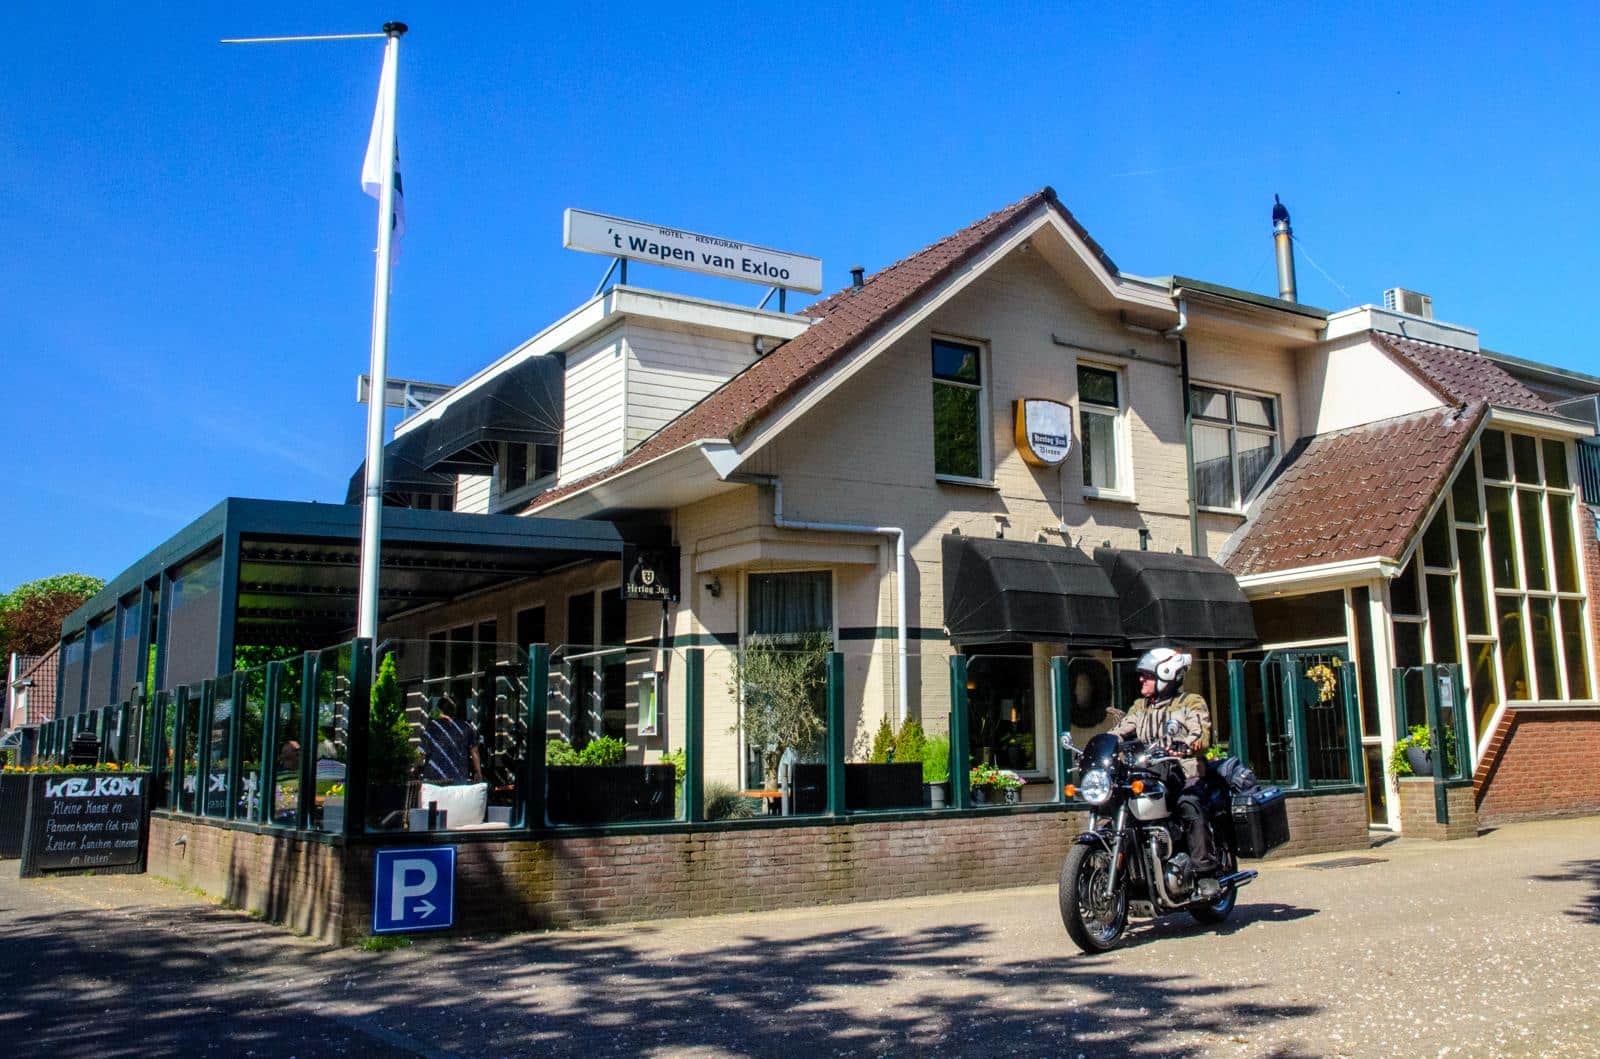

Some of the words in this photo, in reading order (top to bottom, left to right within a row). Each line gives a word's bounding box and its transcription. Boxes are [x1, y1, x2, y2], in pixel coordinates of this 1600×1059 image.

[659, 228, 684, 239] HOTEL
[695, 235, 743, 251] RESTAURANT
[628, 235, 695, 262] Wapen
[702, 253, 734, 270] van
[742, 258, 790, 280] Exloo
[44, 776, 143, 798] WELKOM
[51, 800, 82, 815] Kleine
[391, 858, 438, 921] P
